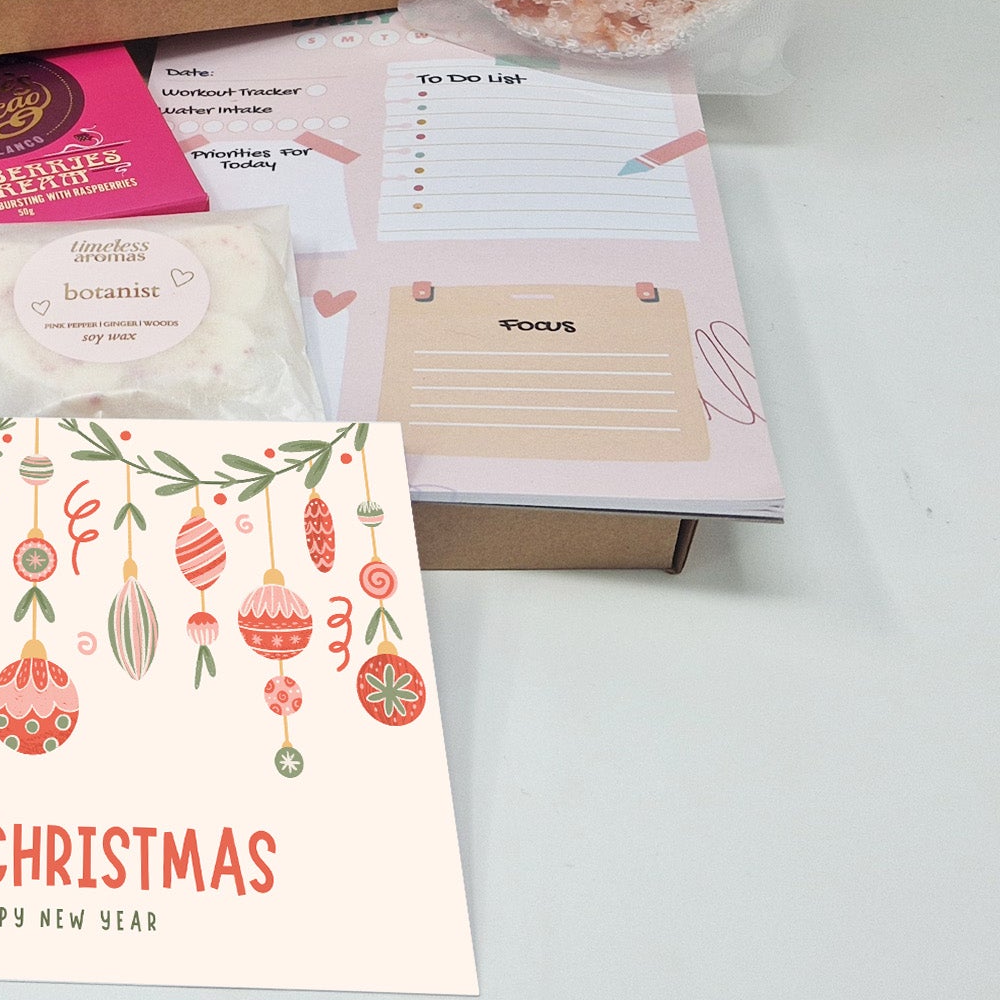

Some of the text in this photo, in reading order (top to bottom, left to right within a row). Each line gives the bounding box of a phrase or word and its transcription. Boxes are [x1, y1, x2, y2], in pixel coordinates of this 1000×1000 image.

[165, 68, 214, 77] Date:
[416, 74, 442, 84] To
[488, 72, 528, 84] List
[161, 87, 302, 97] Workout Tracker
[218, 106, 273, 114] Intake
[190, 148, 313, 160] Priorities For
[220, 160, 277, 171] Today
[46, 189, 72, 202] WITH
[73, 177, 138, 198] RASPBERRIES
[18, 207, 35, 217] 50g
[70, 238, 150, 253] timeless
[74, 252, 146, 263] aromas
[63, 282, 160, 301] botanist
[67, 321, 98, 329] PEPPER
[103, 320, 138, 328] GINGER
[498, 319, 577, 333] Focus
[81, 332, 137, 345] soy wax
[39, 906, 87, 931] NEW
[99, 908, 157, 932] YEAR
